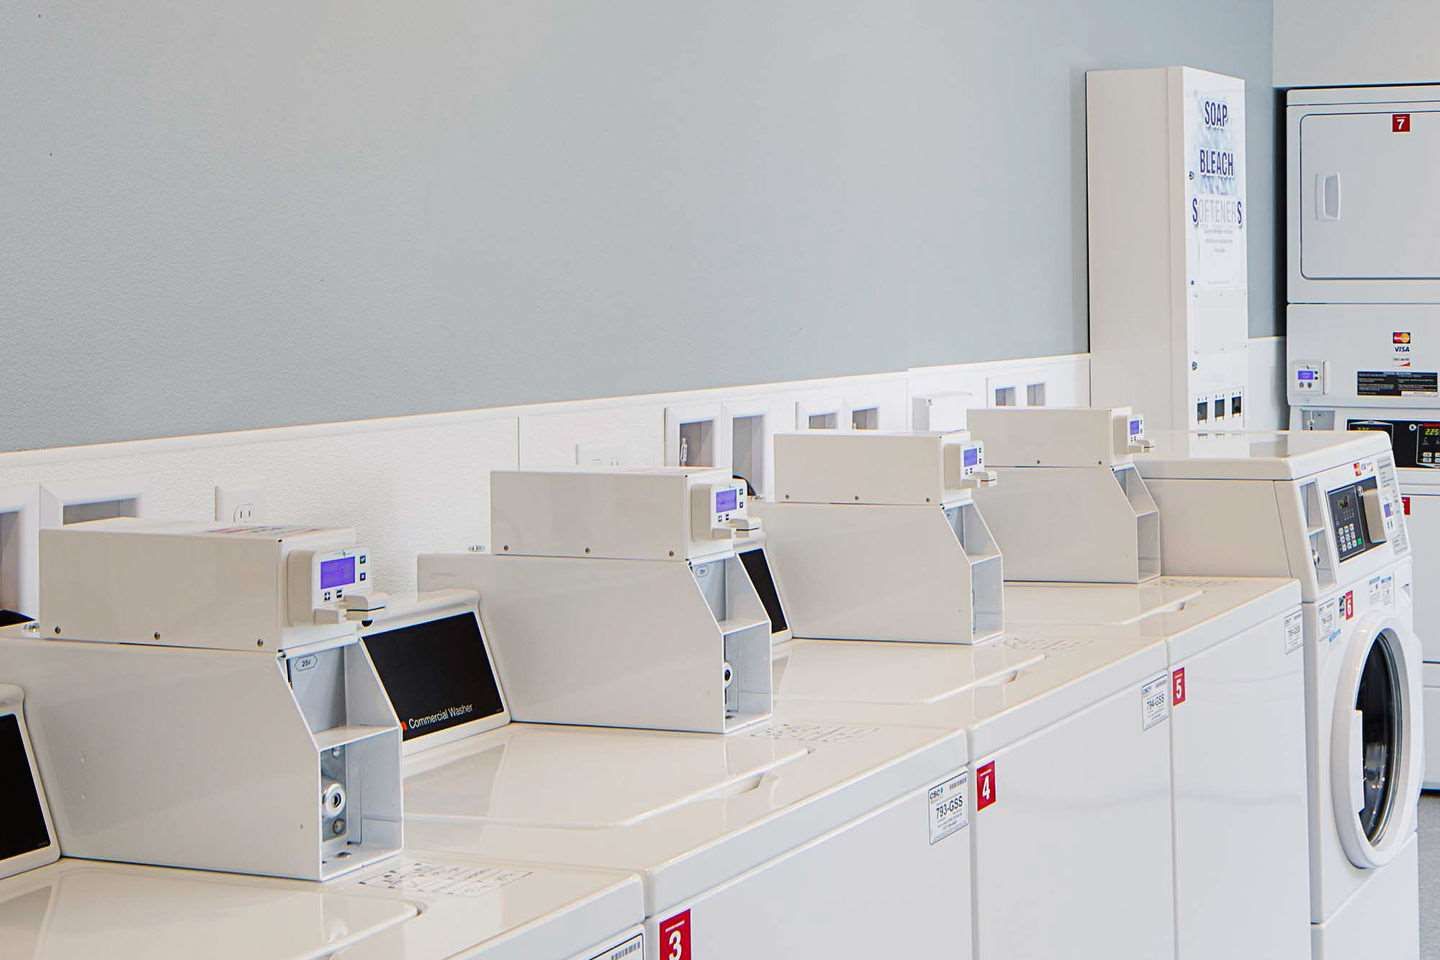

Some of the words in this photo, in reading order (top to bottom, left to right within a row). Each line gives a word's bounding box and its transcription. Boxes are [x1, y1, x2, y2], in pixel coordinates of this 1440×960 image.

[1204, 101, 1228, 127] SOAP
[1396, 119, 1405, 130] 7
[1200, 149, 1234, 177] BLEACH
[1347, 602, 1352, 616] 6
[1176, 678, 1182, 699] 5
[408, 707, 449, 729] Commercial
[448, 703, 473, 719] Washer
[982, 775, 991, 801] 4
[936, 795, 963, 819] 793-GSS
